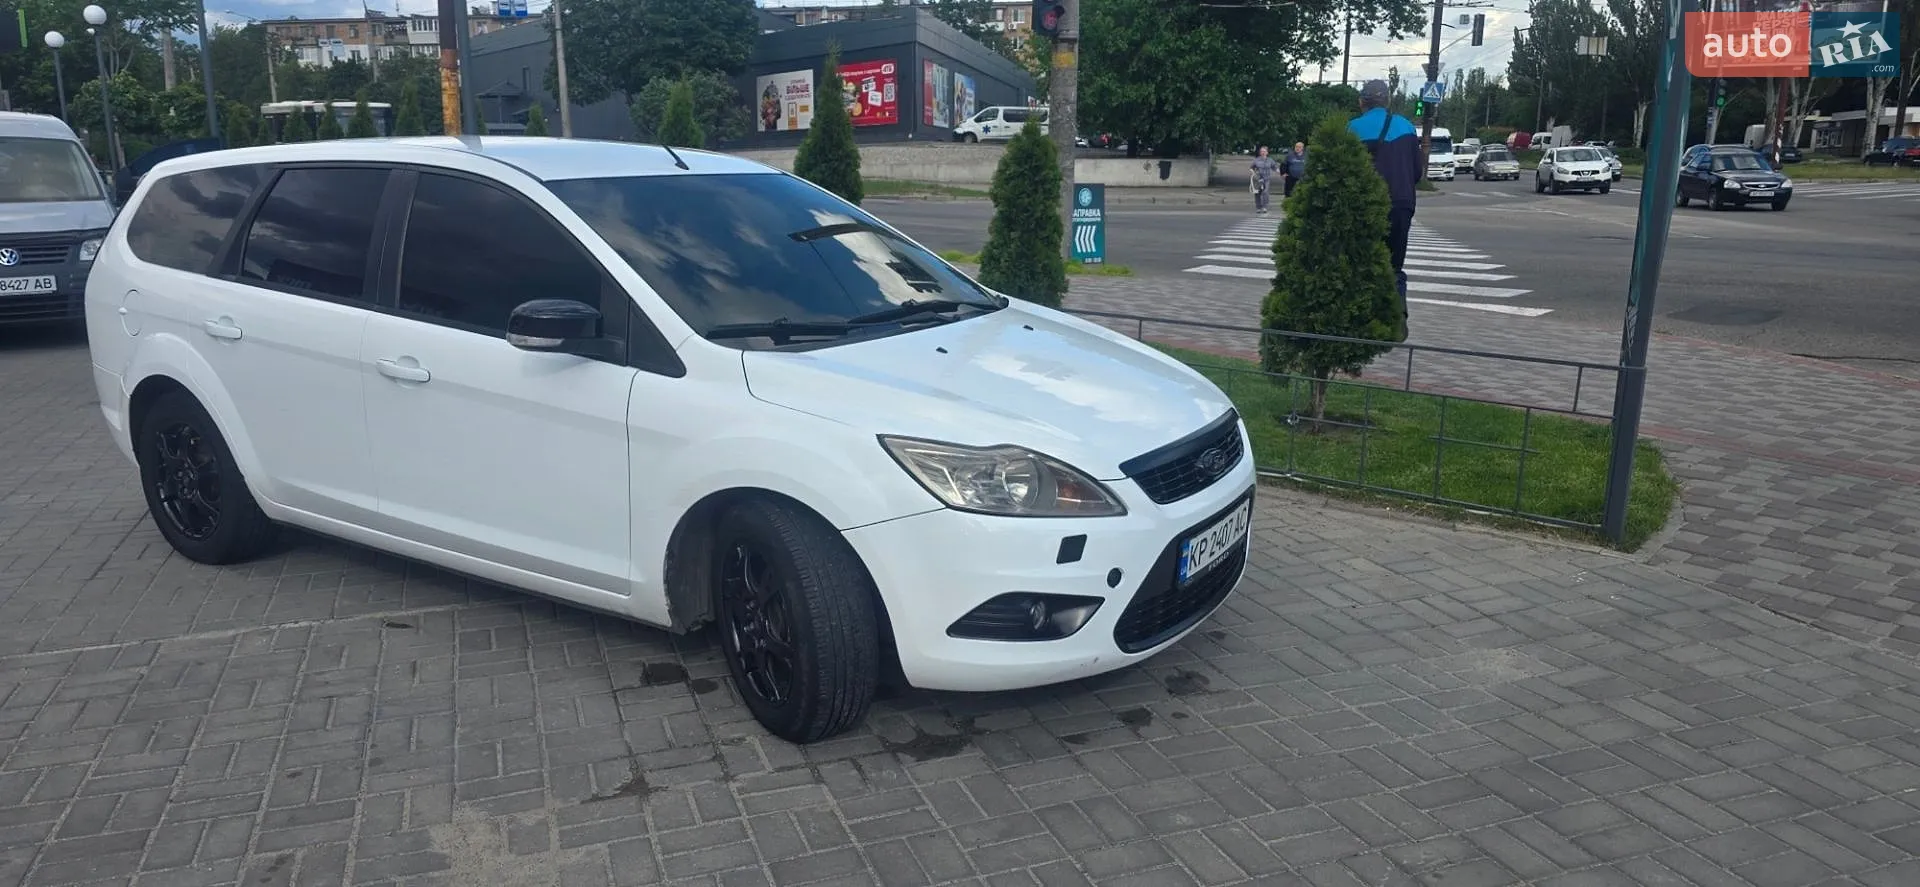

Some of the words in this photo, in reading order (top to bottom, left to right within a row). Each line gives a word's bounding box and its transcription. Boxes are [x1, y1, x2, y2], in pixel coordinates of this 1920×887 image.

[1072, 208, 1101, 217] АПРАВКА
[0, 279, 29, 291] 8427
[34, 278, 52, 289] AB
[1189, 537, 1208, 571] KP
[1209, 517, 1234, 558] 2407
[1233, 506, 1247, 539] AC
